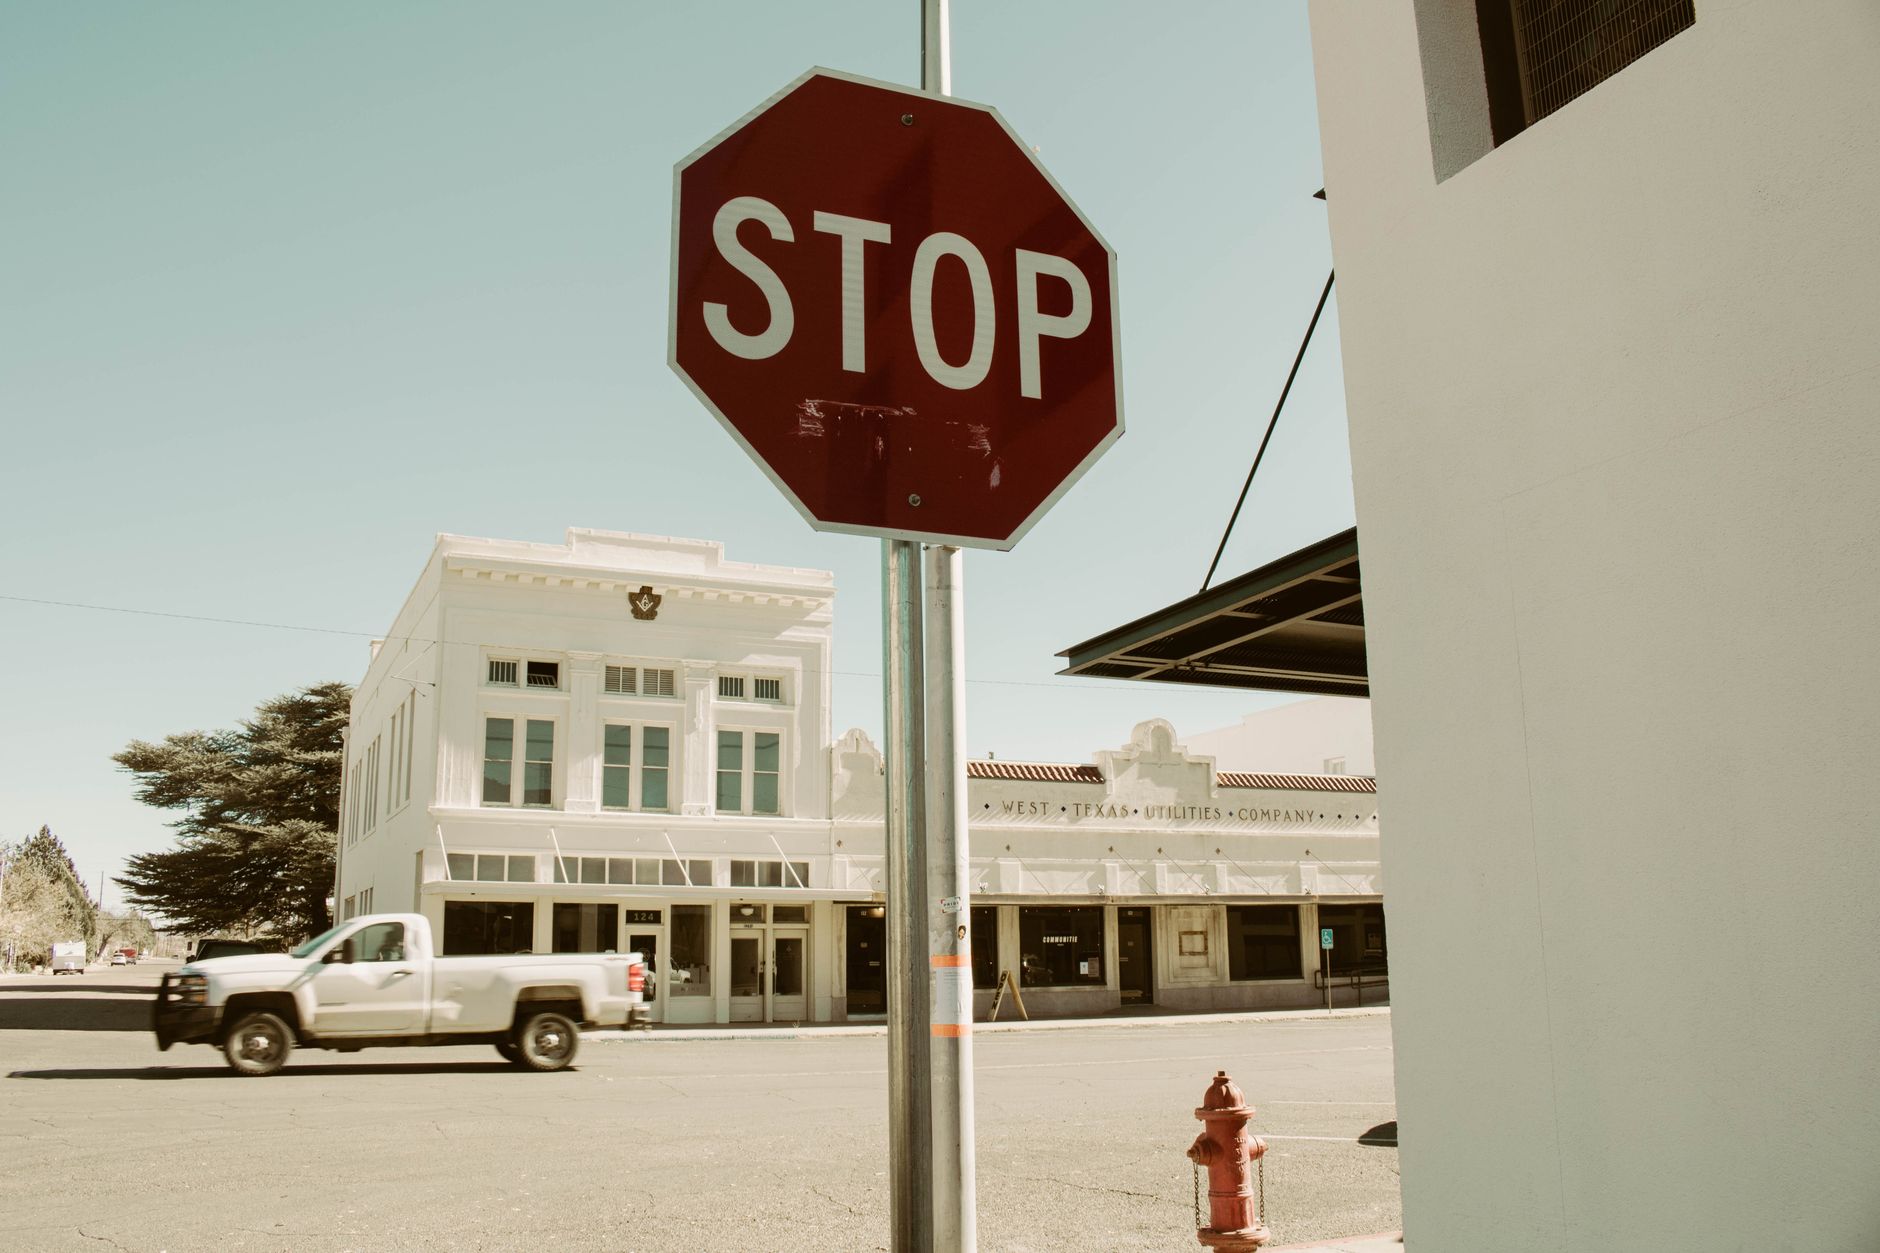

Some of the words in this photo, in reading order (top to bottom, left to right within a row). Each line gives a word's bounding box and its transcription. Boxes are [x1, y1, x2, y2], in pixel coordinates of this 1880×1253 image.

[702, 196, 1093, 400] STOP
[1002, 800, 1049, 816] WEST
[1073, 802, 1129, 818] TEXAS
[1144, 805, 1221, 820] UTILITIES
[1238, 807, 1314, 823] COMPANY
[634, 912, 654, 921] 124
[991, 970, 1009, 1010] OPEN
